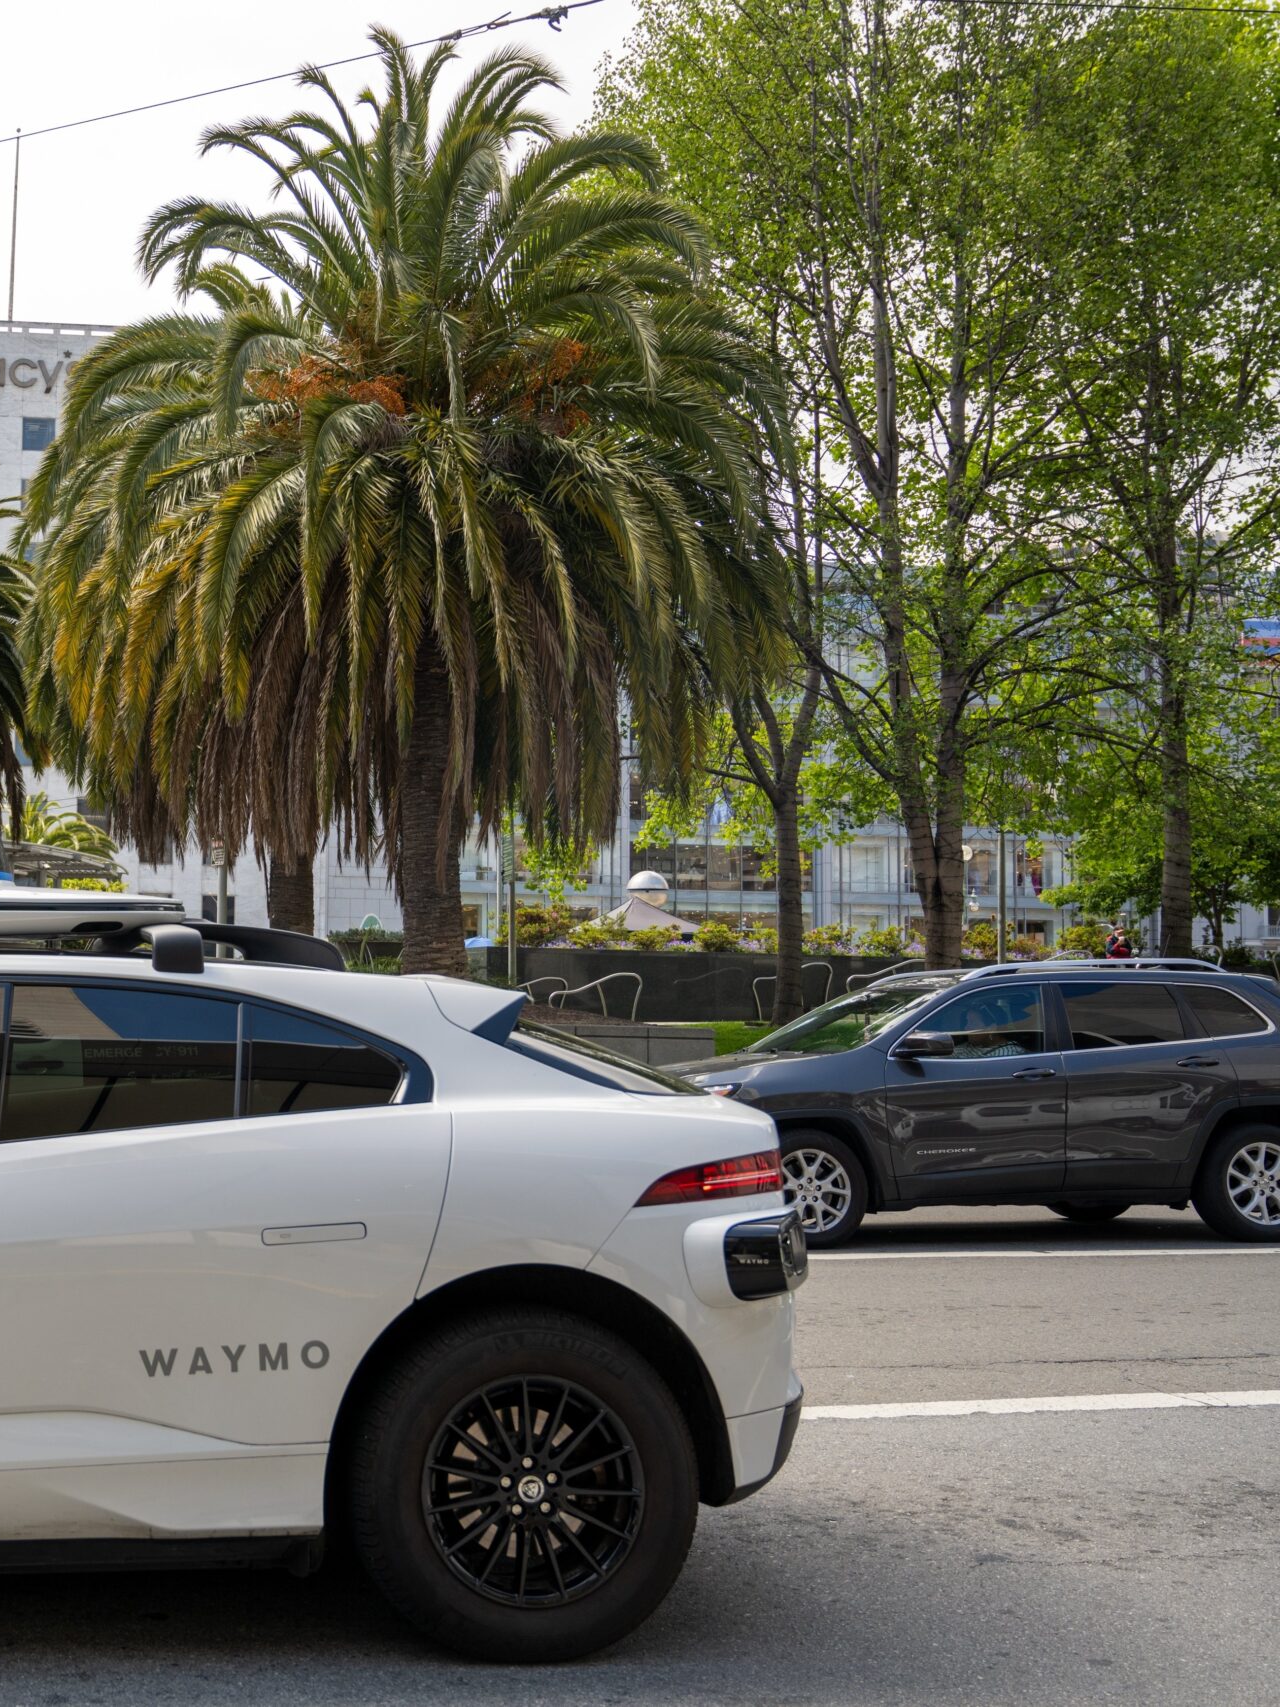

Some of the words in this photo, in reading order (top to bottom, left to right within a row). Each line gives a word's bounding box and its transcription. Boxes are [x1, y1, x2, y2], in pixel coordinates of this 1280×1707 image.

[178, 1046, 199, 1057] 911
[916, 1147, 977, 1155] CHEROKEE
[138, 1339, 330, 1378] WAYMO
